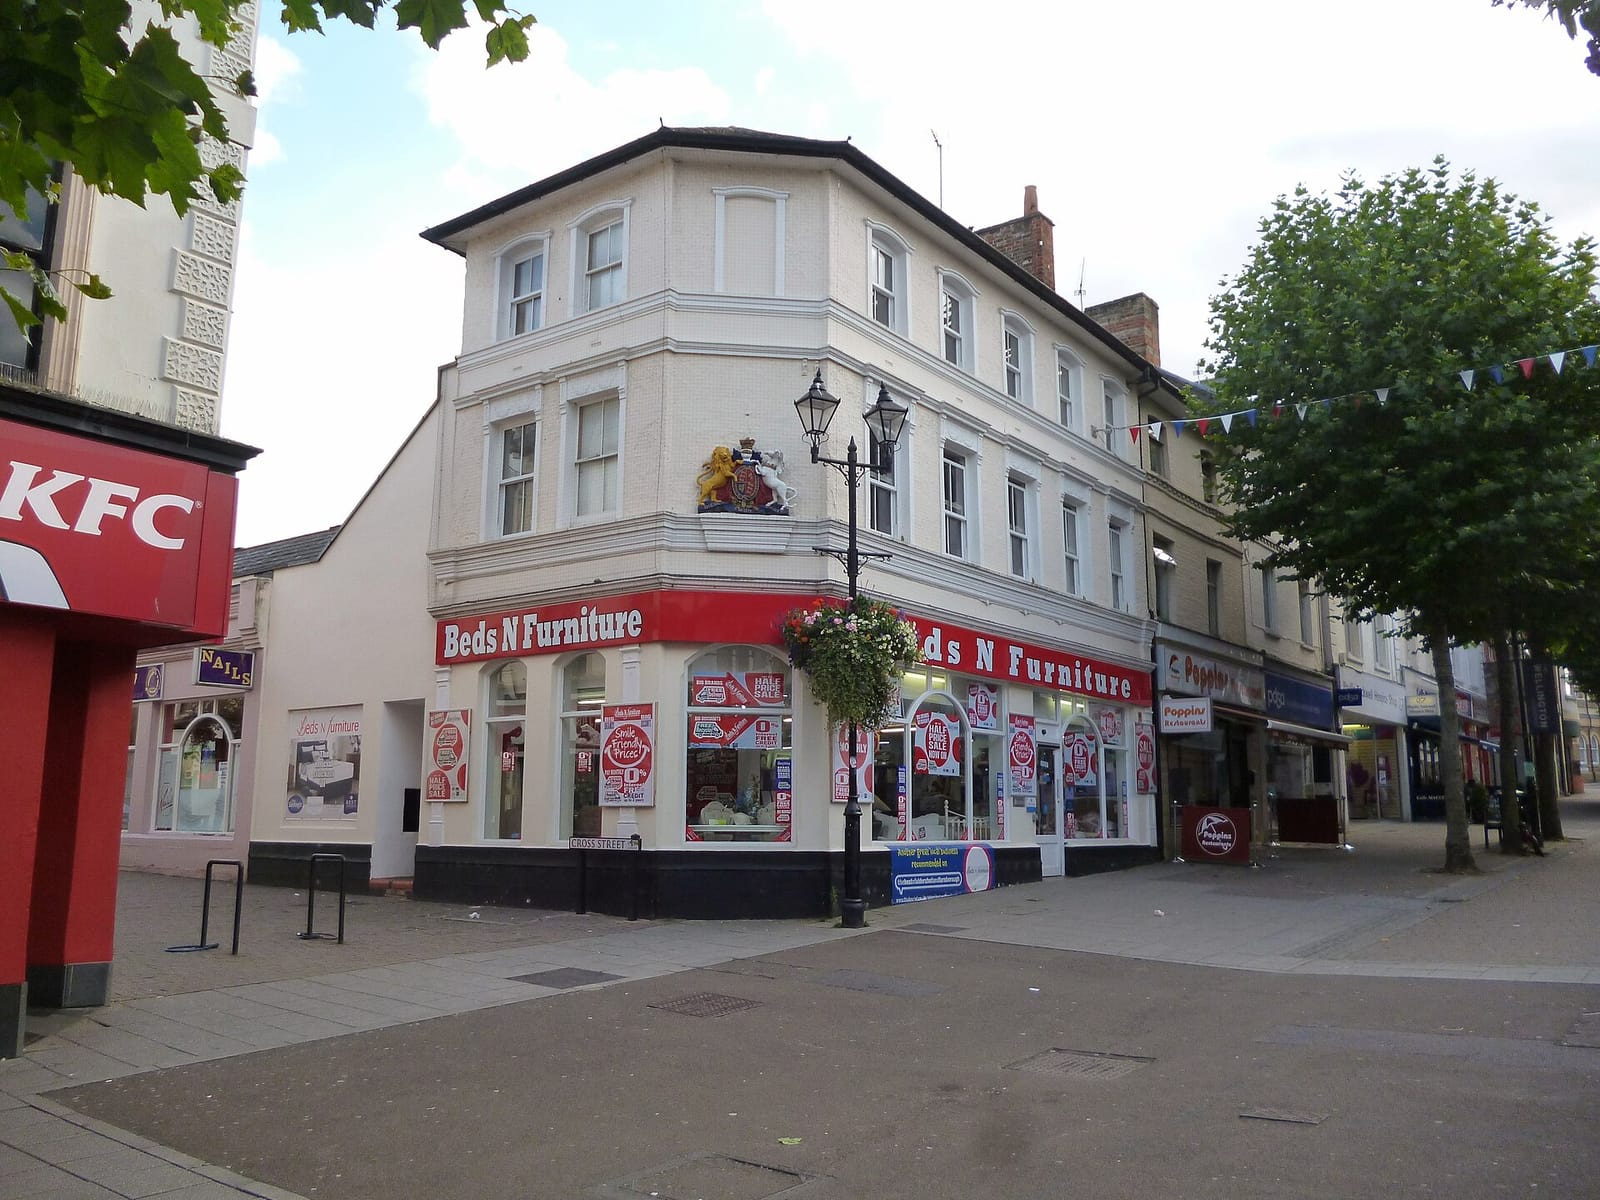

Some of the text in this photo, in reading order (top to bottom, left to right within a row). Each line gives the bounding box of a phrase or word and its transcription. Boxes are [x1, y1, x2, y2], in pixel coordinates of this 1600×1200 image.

[0, 461, 195, 550] KFC
[444, 606, 642, 658] Beds N Furniture
[202, 650, 251, 685] NAILS
[923, 627, 1131, 698] ds N Furniture
[755, 677, 781, 685] HALF
[1185, 656, 1228, 695] Poppins
[1267, 687, 1285, 708] pdsa
[1164, 705, 1205, 718] Poppins
[615, 726, 636, 738] Smile
[929, 725, 947, 733] HALF
[929, 733, 947, 742] PRICE
[611, 737, 642, 754] Friendly
[929, 741, 947, 750] SALE
[1140, 741, 1152, 753] SALE
[624, 767, 647, 783] 0%
[1203, 831, 1232, 840] Poppins
[571, 838, 626, 849] CROSS STREET
[911, 858, 941, 868] recommended
